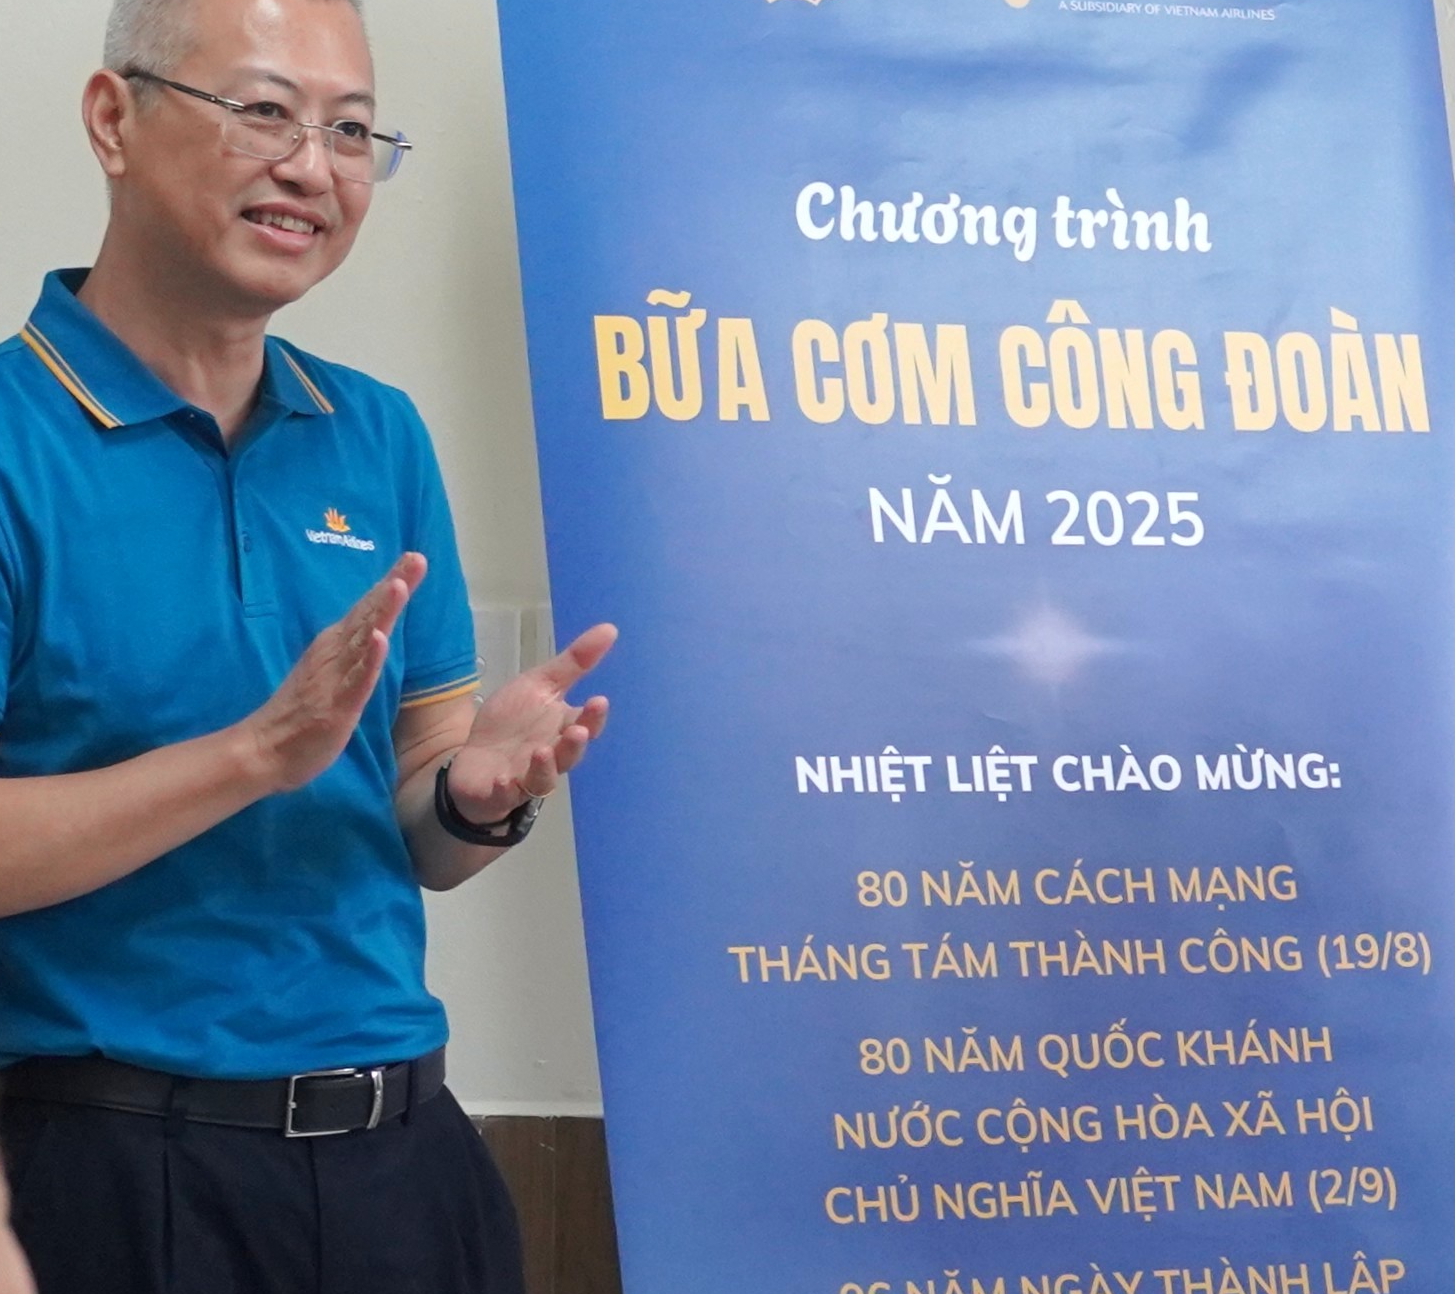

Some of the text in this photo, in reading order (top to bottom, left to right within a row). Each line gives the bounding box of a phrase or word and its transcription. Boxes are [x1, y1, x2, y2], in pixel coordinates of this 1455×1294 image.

[1058, 0, 1275, 21] A SUBSIDIARY OF VIETNAM AIRLINES
[795, 181, 1215, 264] Chương trình
[591, 287, 1433, 435] BỮA CƠM CÔNG ĐOÀN
[868, 473, 1207, 549] NĂM 2025
[795, 743, 1344, 805] NHIỆT LIỆT CHÀO MỪNG:
[856, 858, 1300, 913] 80 NĂM CÁCH MẠNG
[726, 927, 1434, 986] THÁNG TÁM THÀNH CÔNG (19/8)
[858, 1017, 1336, 1081] 80 NĂM QUỐC KHÁNH
[833, 1086, 1376, 1155] NƯỚC CỘNG HÒA XÃ HỘI
[823, 1166, 1400, 1227] CHỦ NGHĨA VIỆT NAM (2/9)
